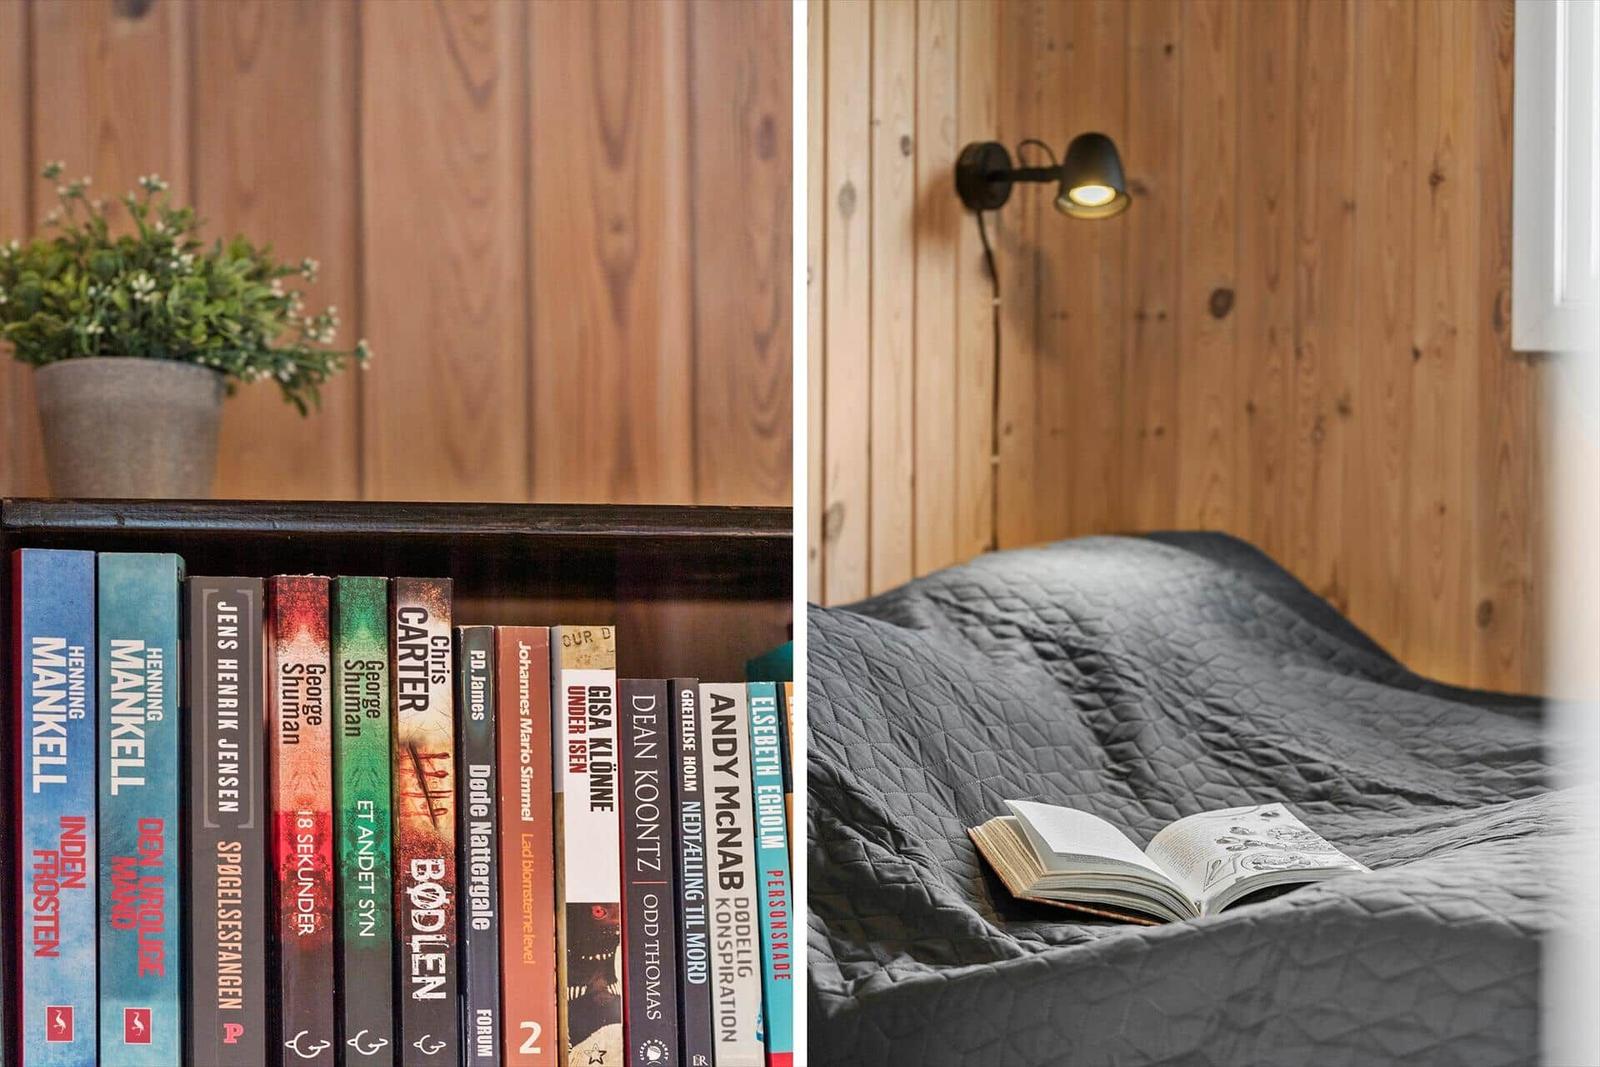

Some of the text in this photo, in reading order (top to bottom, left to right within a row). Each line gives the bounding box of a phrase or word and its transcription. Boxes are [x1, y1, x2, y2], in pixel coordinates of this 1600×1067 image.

[398, 606, 429, 712] CARTER
[431, 635, 450, 685] Chris
[562, 630, 593, 647] OUR
[32, 637, 67, 793] MANKELL
[68, 645, 85, 720] HENNING
[110, 639, 145, 796] MANKELL
[146, 647, 163, 721] HENNING
[217, 601, 239, 812] JENS HENRIK JENSEN
[282, 663, 304, 745] Shuman
[302, 663, 326, 726] George
[345, 659, 365, 737] Shuman
[362, 660, 384, 719] George
[470, 675, 486, 721] James
[518, 640, 534, 821] Johannes Mario Simmel
[567, 685, 587, 774] UNDER ISEN
[588, 685, 616, 812] GISA KLÖNNE
[680, 689, 697, 792] GRETELISE HOLM
[710, 693, 739, 779] ANDY
[751, 696, 785, 849] ELSEBETH EGHOLM
[632, 694, 661, 872] DEAN KOONTZ
[60, 816, 86, 888] INDEN
[137, 817, 164, 868] DEN
[297, 808, 315, 935] 18 SEKUNDER
[357, 800, 375, 937] ET ANDET SYN
[469, 764, 493, 931] Døde Nattergale
[521, 833, 534, 858] Lad
[33, 850, 60, 958] FROSTEN
[111, 856, 138, 930] MAND
[217, 840, 242, 1010] SPØGELSESFANGEN
[406, 858, 450, 1000] BØDLEN
[643, 894, 659, 936] ODD
[682, 801, 707, 985] NEDTÆLLING TIL MORD
[767, 870, 791, 980] PERSONSKADE
[644, 939, 661, 1020] THOMAS
[715, 898, 737, 1043] KONSPIRATION
[735, 897, 753, 977] DØDELIG
[223, 1022, 244, 1044] P
[476, 1008, 492, 1057] FORUM
[519, 1021, 541, 1054] 2
